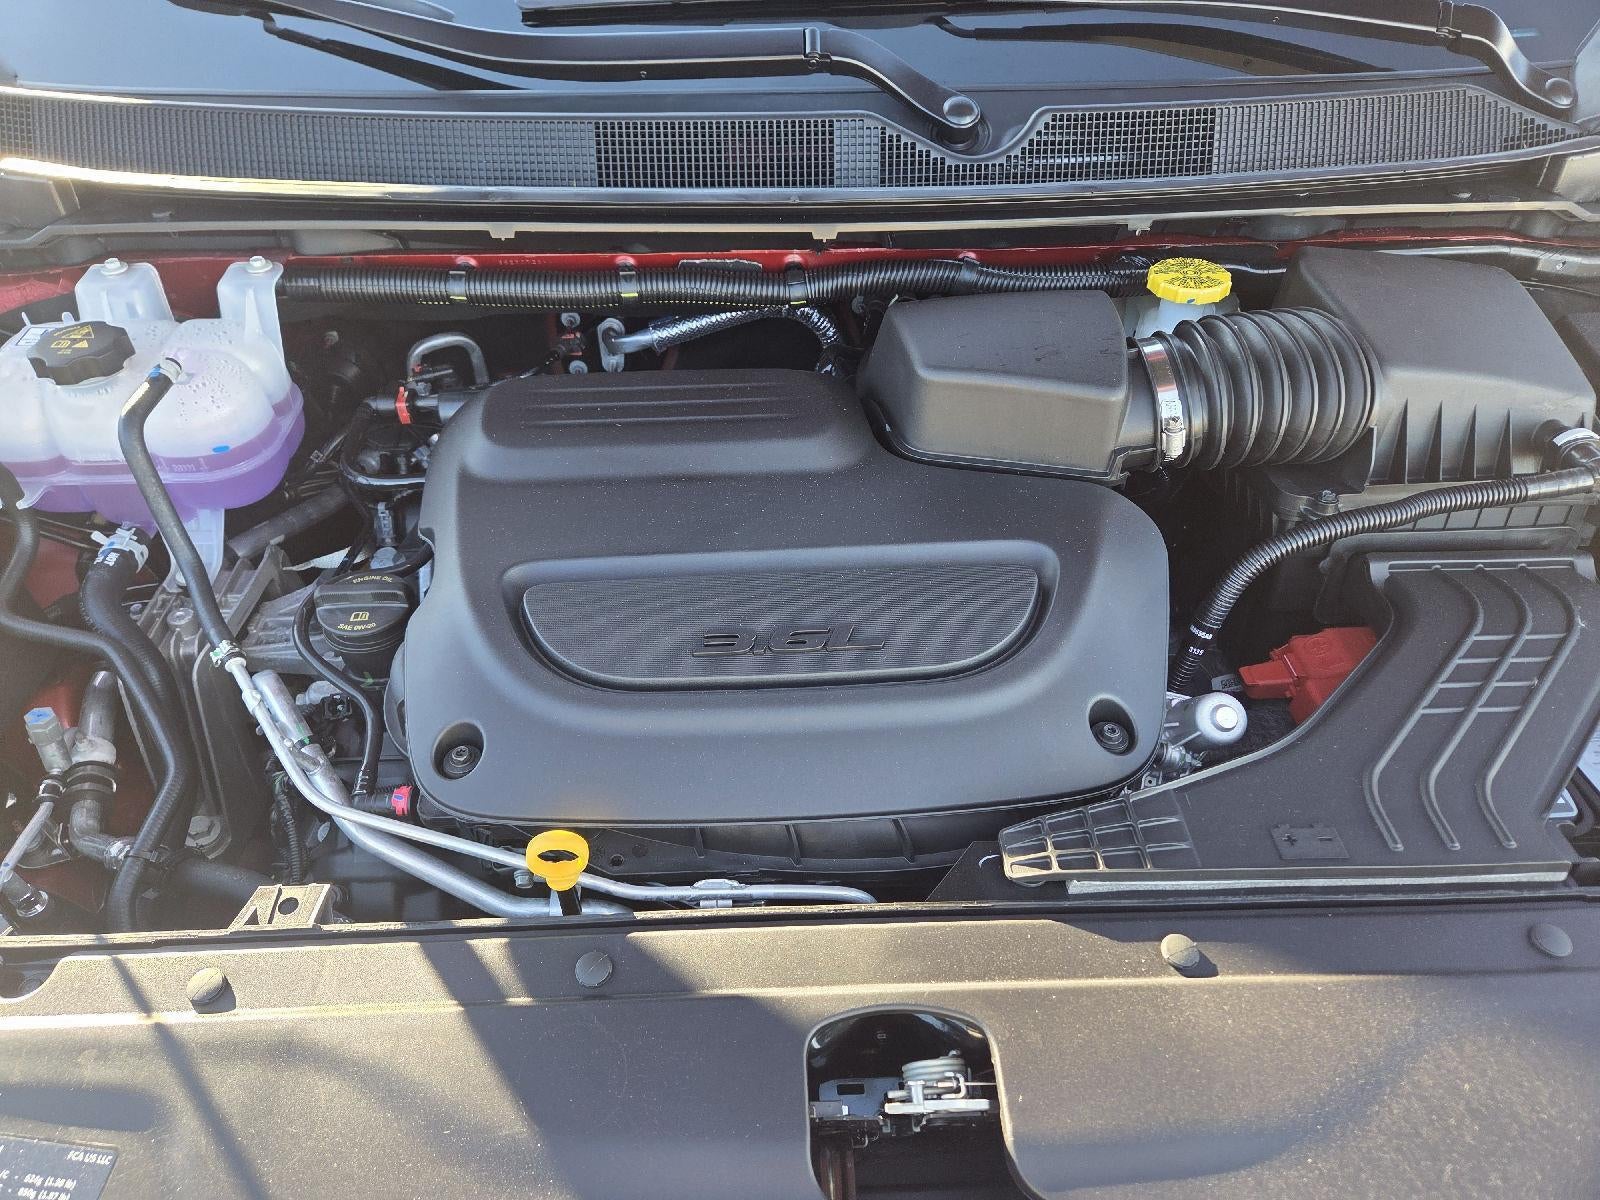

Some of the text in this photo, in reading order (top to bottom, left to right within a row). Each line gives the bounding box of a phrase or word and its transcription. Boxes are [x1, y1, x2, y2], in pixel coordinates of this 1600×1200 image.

[352, 575, 392, 584] ENGINE OIL
[337, 623, 353, 631] SAE
[692, 625, 885, 657] 3.6L
[66, 1150, 112, 1165] FCA US LLC
